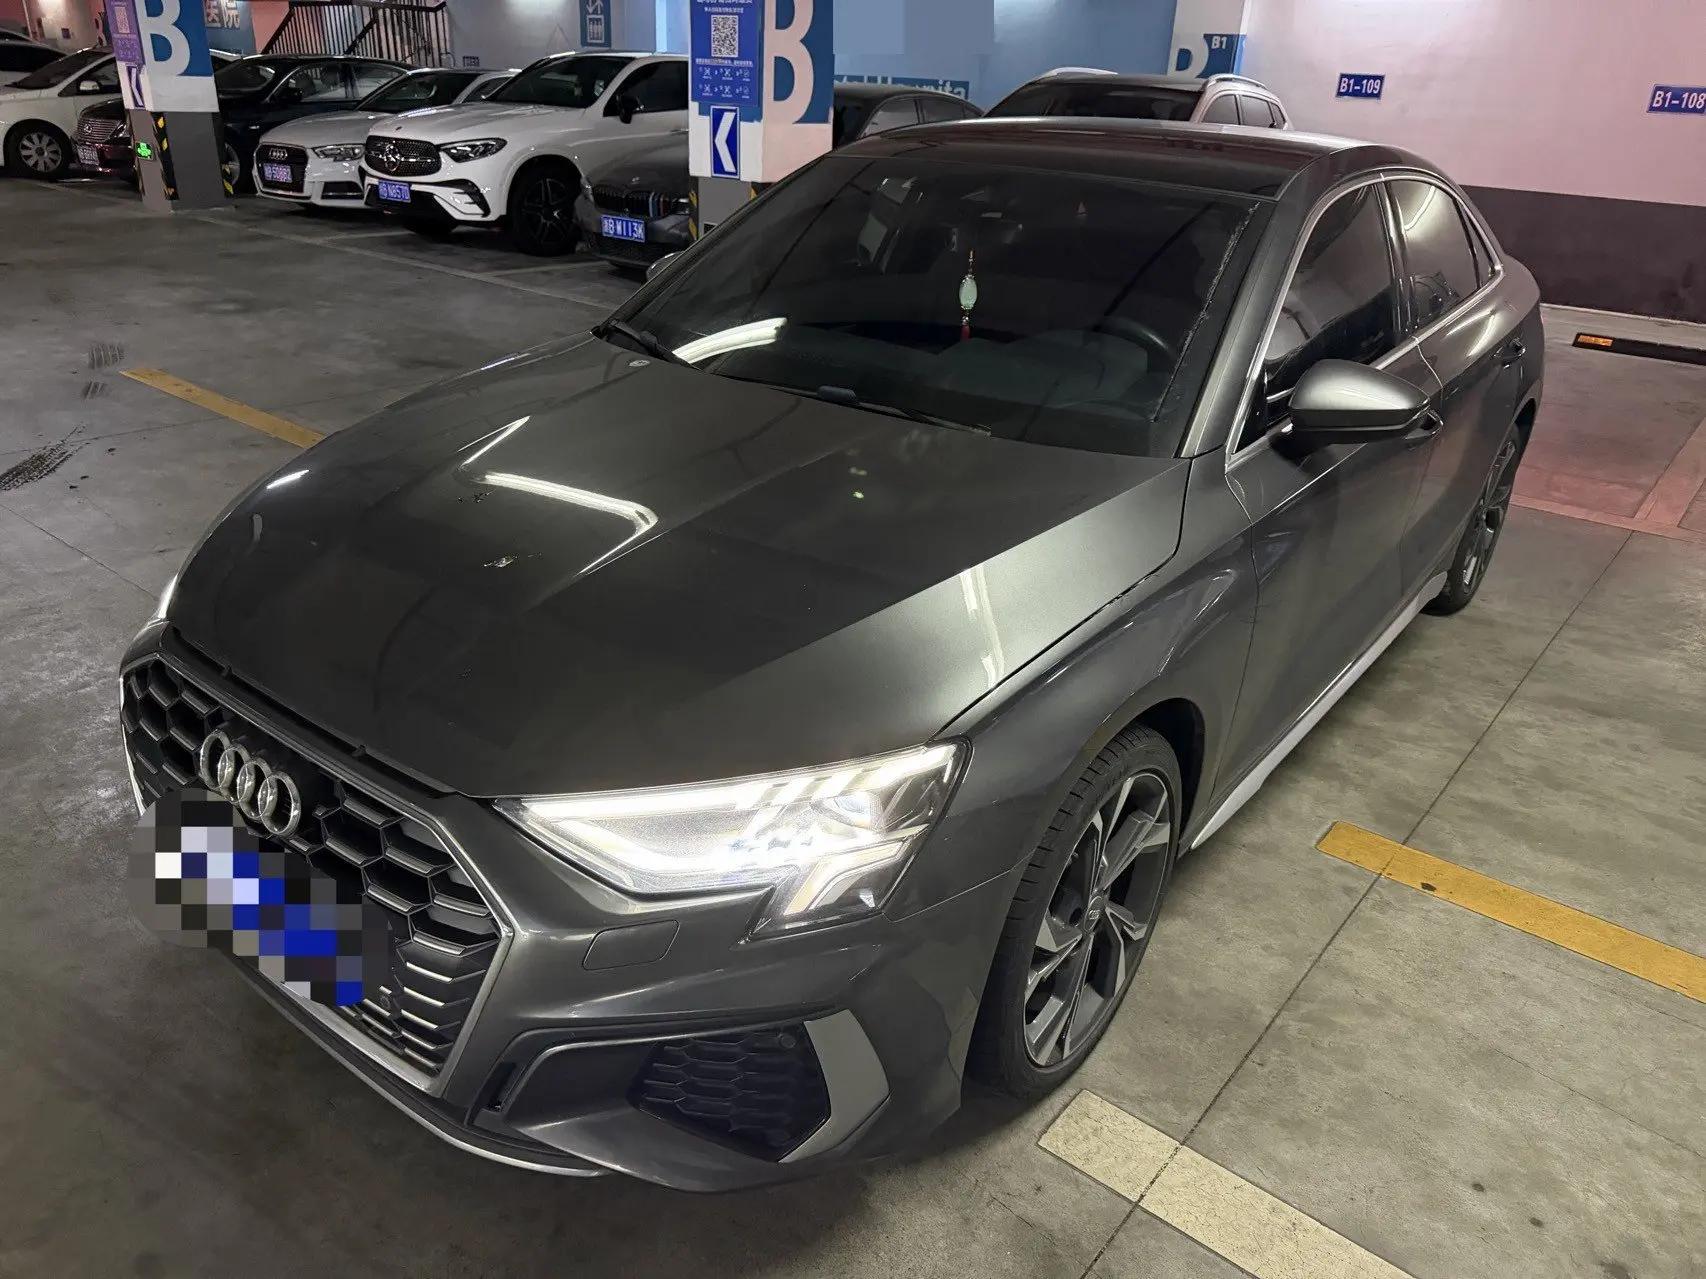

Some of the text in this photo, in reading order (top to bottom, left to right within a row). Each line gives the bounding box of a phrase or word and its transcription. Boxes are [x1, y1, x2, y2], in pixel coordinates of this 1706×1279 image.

[135, 0, 190, 76] B
[1211, 36, 1228, 49] B1
[762, 0, 814, 124] B
[1339, 77, 1381, 94] B1-109
[1652, 90, 1706, 109] B1-108
